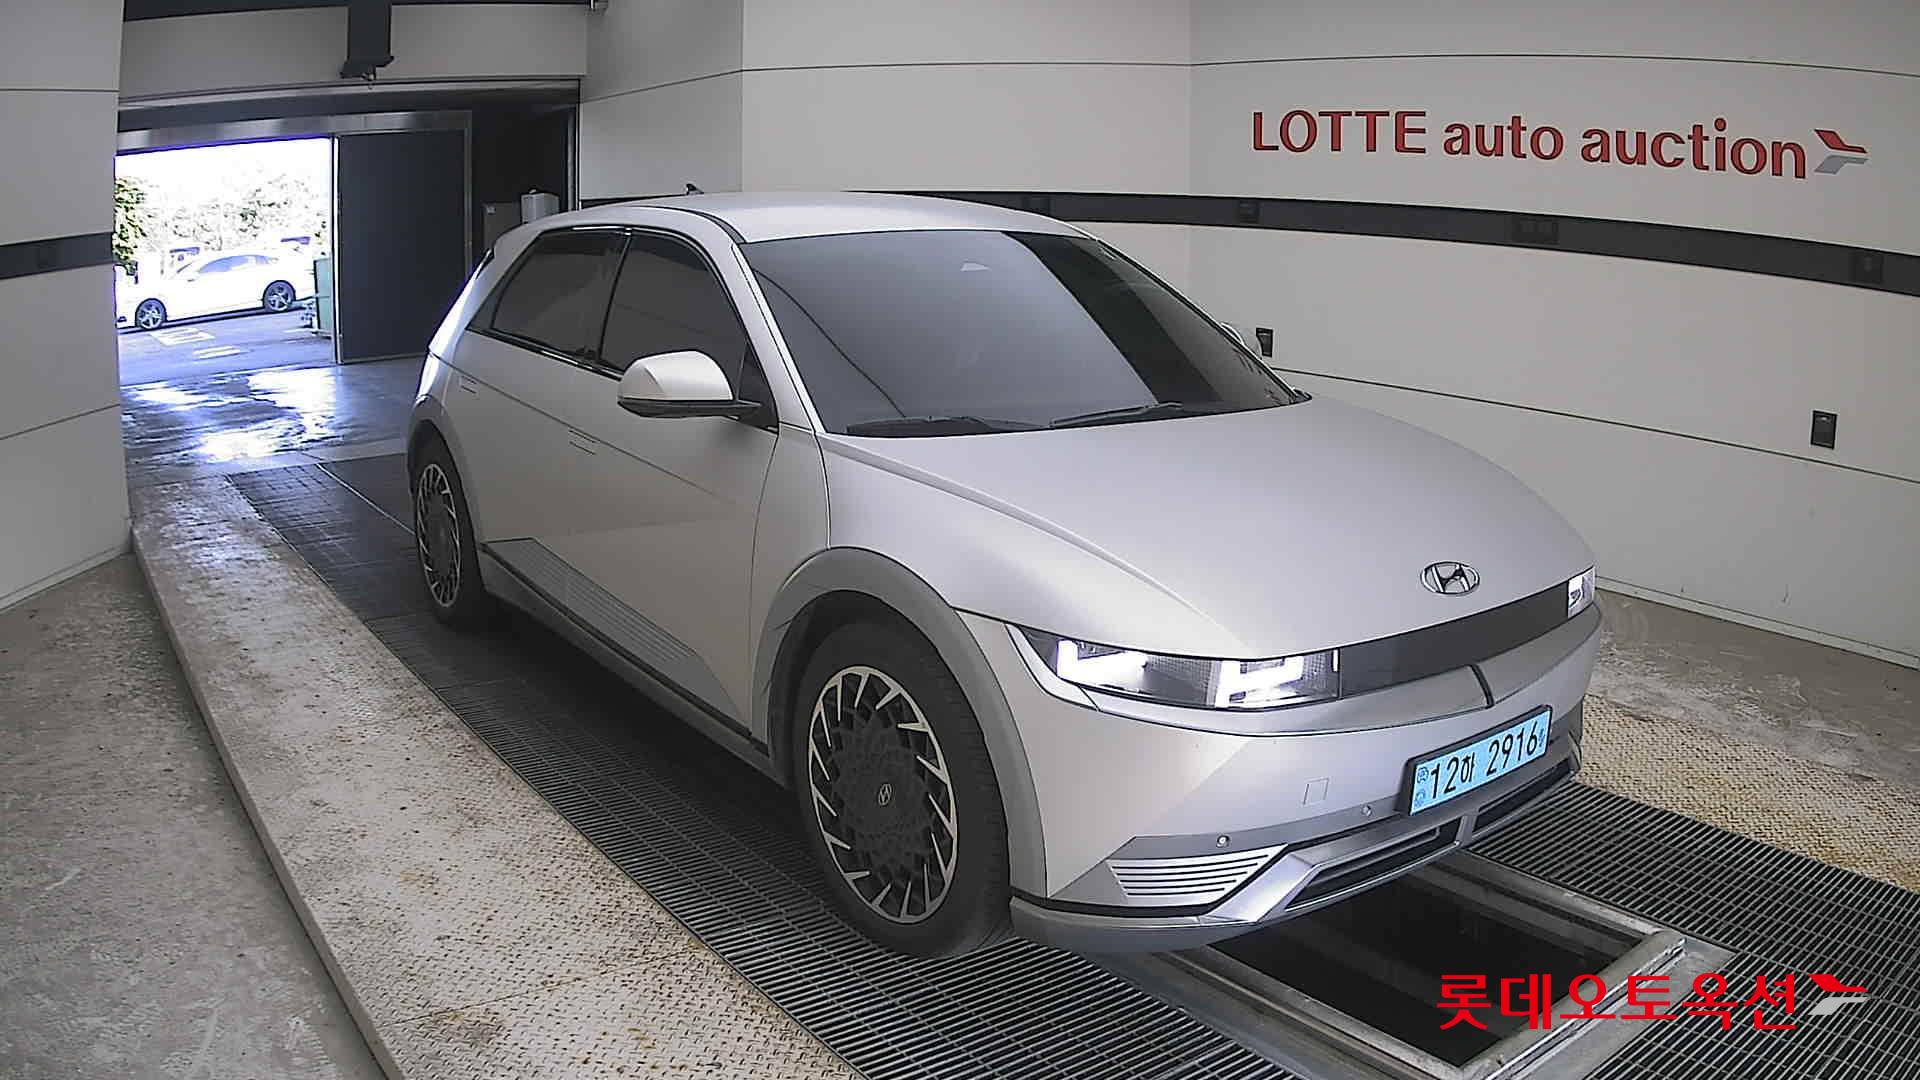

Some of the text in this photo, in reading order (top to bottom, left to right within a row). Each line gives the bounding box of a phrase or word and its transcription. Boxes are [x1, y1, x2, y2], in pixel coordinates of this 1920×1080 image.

[1252, 110, 1807, 179] LOTTE auto auction
[1430, 720, 1538, 800] 12하 2916
